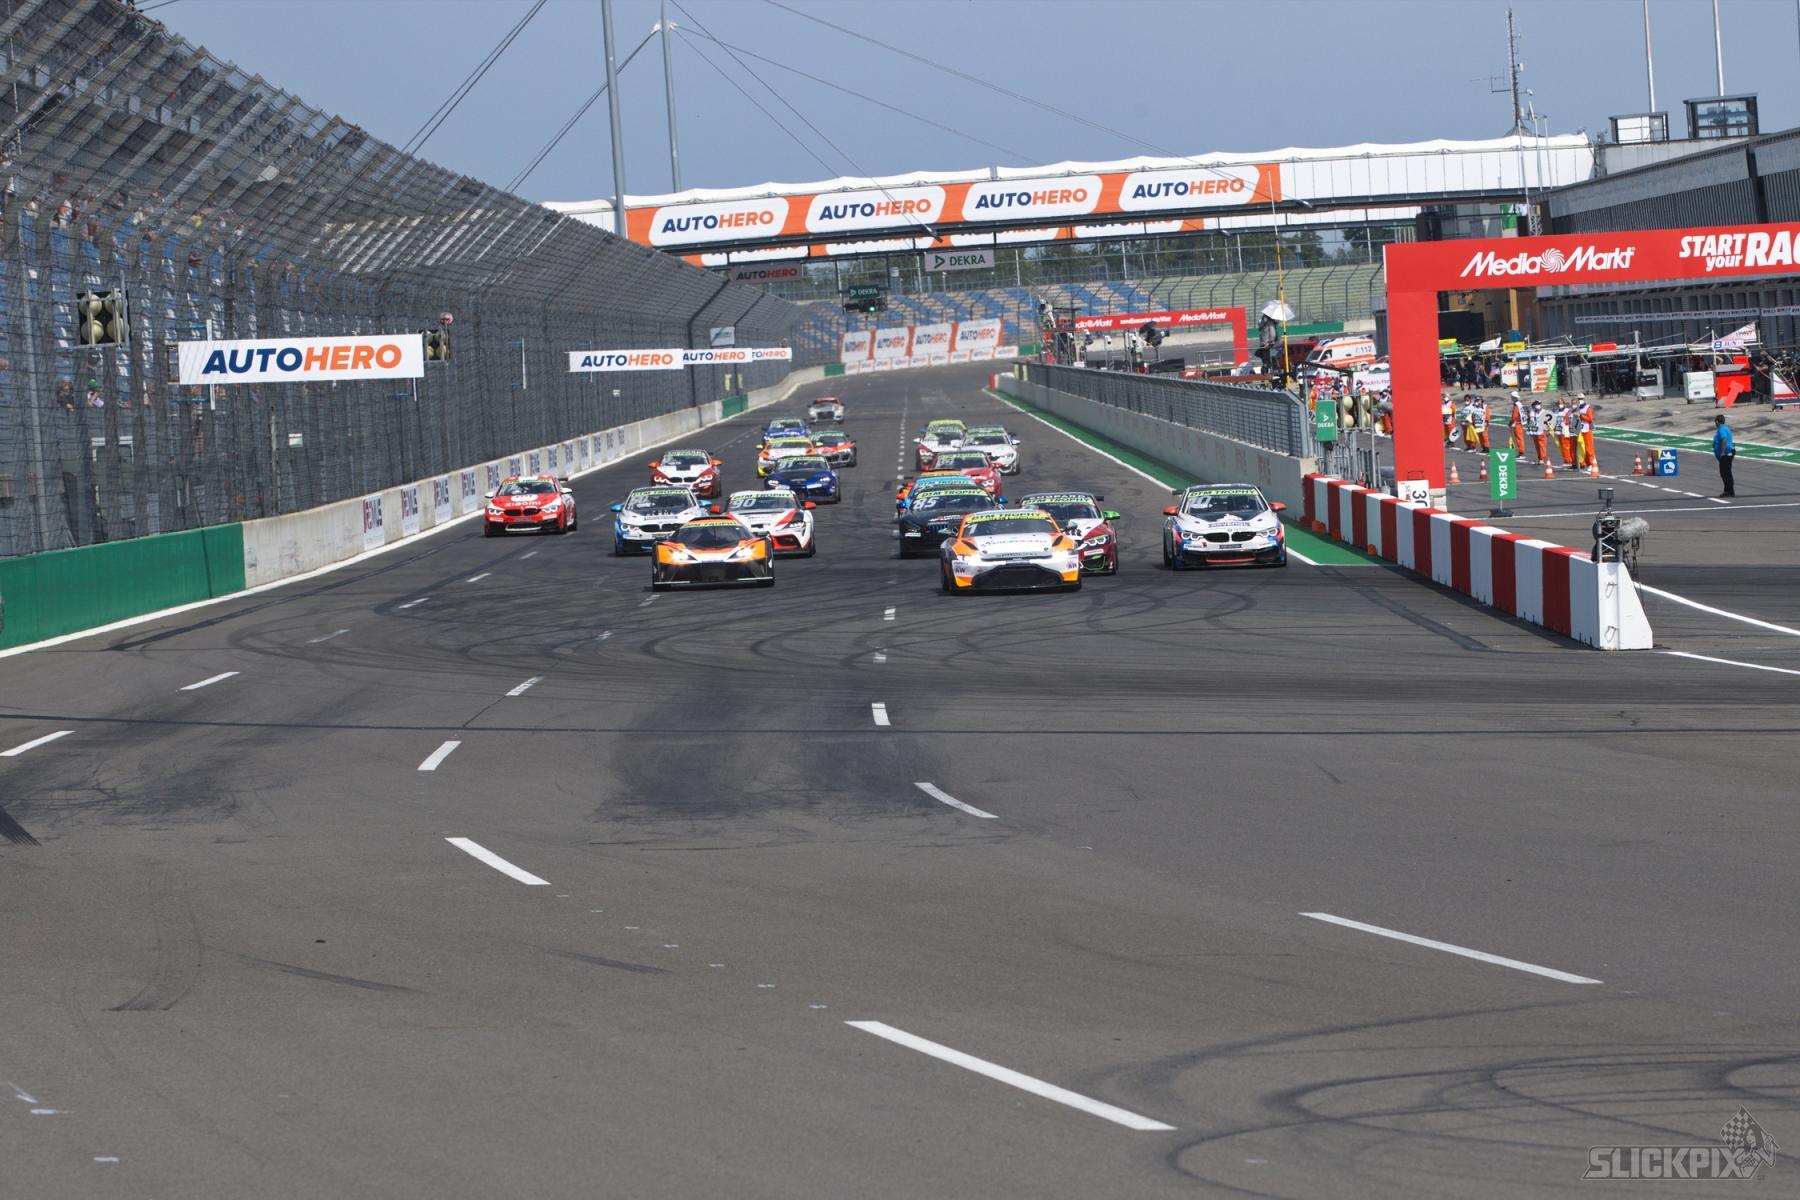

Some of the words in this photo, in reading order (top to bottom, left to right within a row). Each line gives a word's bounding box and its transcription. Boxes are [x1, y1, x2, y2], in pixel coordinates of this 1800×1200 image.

[1132, 178, 1245, 199] AUTOHERO
[975, 188, 1088, 209] AUTOHERO
[819, 199, 932, 221] AUTOHERO
[662, 210, 774, 233] AUTOHERO
[1679, 233, 1746, 258] START
[949, 254, 986, 267] DEKRA
[1706, 254, 1743, 272] your
[736, 267, 798, 281] AUTOHERO
[857, 287, 878, 296] DEKRA
[961, 328, 996, 341] AUTOHERO
[202, 344, 403, 375] AUTOHERO
[581, 354, 674, 368] AUTOHERO
[683, 351, 746, 361] AUTOHERO
[1498, 465, 1509, 497] DEKRA
